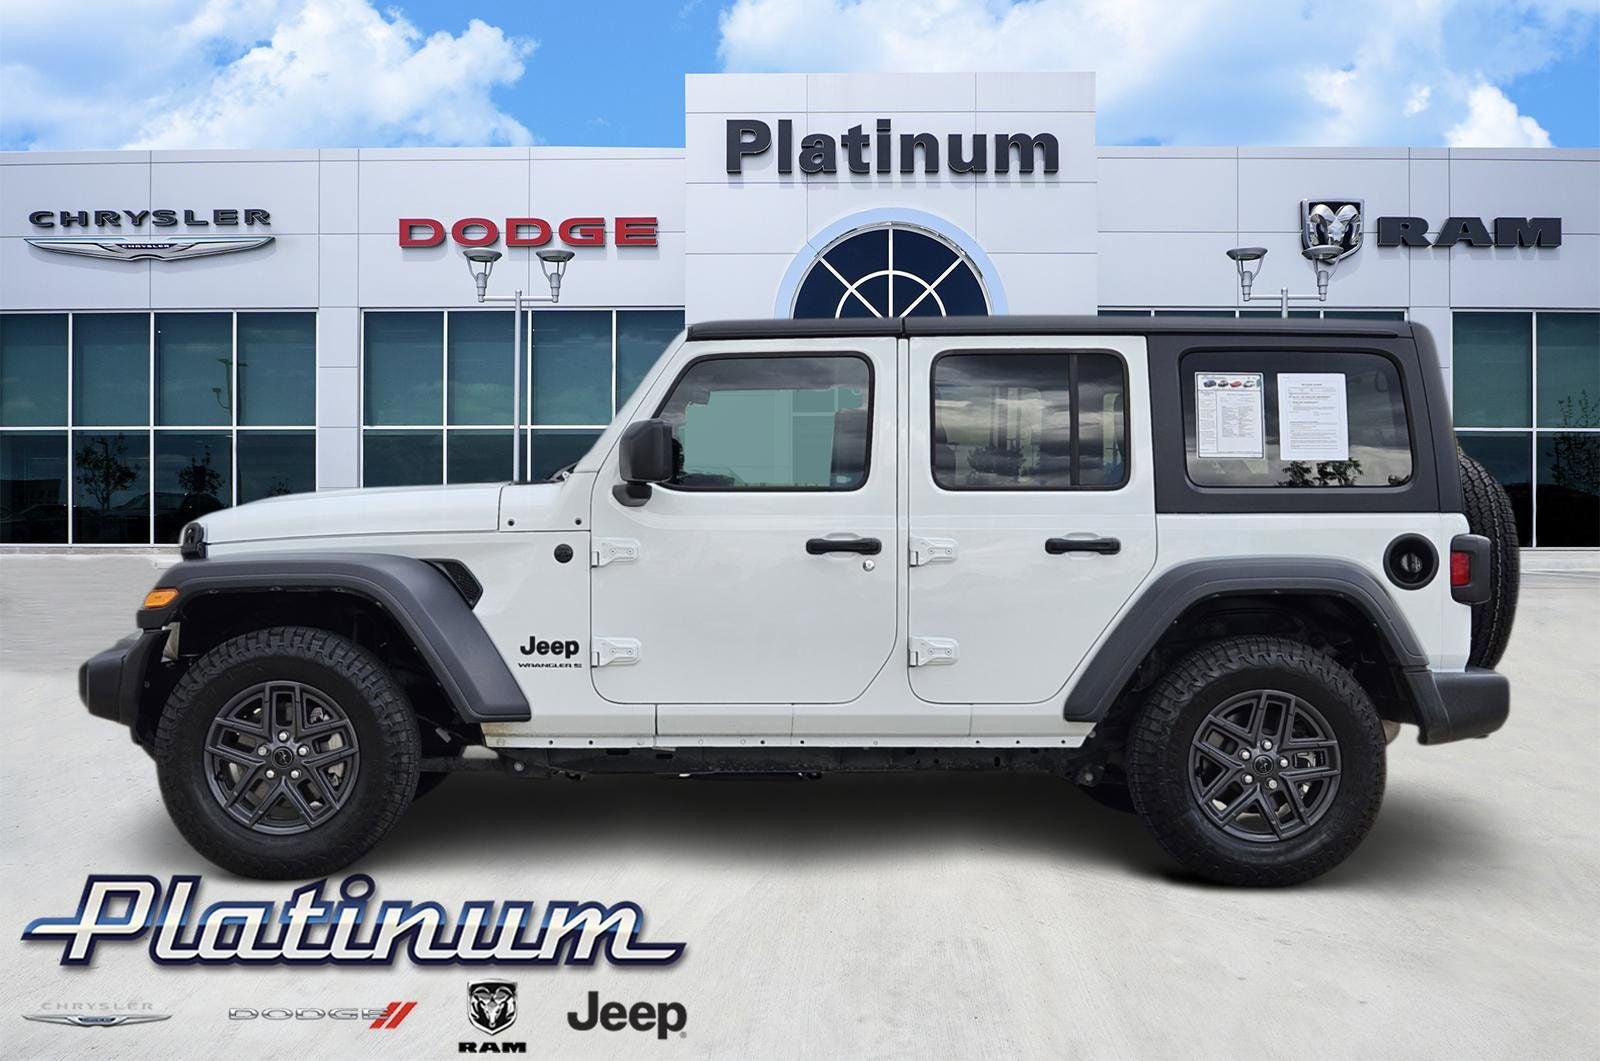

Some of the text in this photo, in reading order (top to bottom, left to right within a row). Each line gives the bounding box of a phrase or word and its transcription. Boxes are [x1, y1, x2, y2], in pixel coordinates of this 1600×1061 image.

[726, 119, 1059, 174] Platinum
[28, 209, 272, 228] CHRYSLER
[399, 217, 658, 248] DODGE
[1377, 217, 1562, 248] RAM
[520, 636, 579, 659] Jeep
